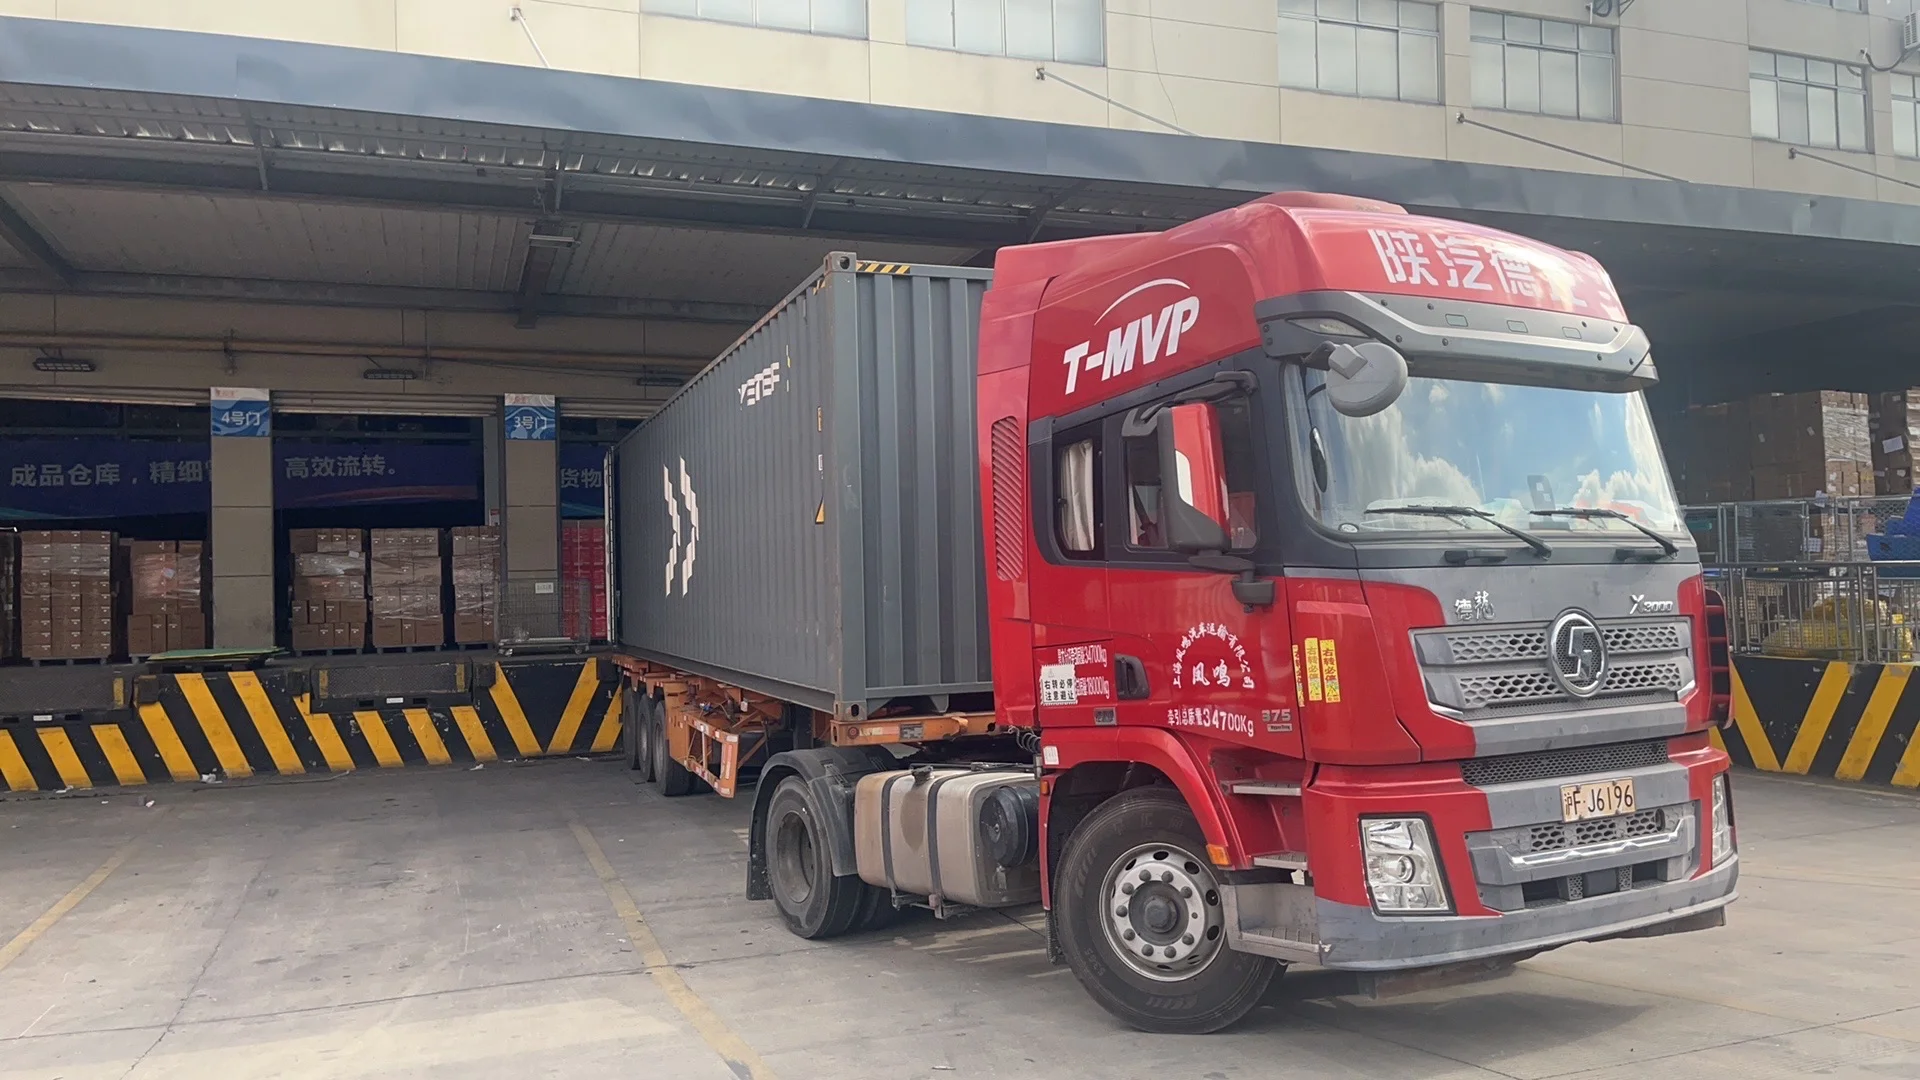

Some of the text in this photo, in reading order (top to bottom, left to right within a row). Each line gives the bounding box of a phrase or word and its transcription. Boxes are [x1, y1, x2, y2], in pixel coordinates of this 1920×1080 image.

[1367, 228, 1590, 308] 陕汽德
[1063, 296, 1200, 395] T-MVP
[221, 410, 260, 426] 4号门
[514, 416, 547, 429] 3号门
[561, 468, 602, 488] 货物
[1630, 594, 1673, 614] X3000
[1044, 678, 1073, 690] 右转必停
[1045, 690, 1075, 701] 注意避让
[1261, 708, 1291, 722] 375
